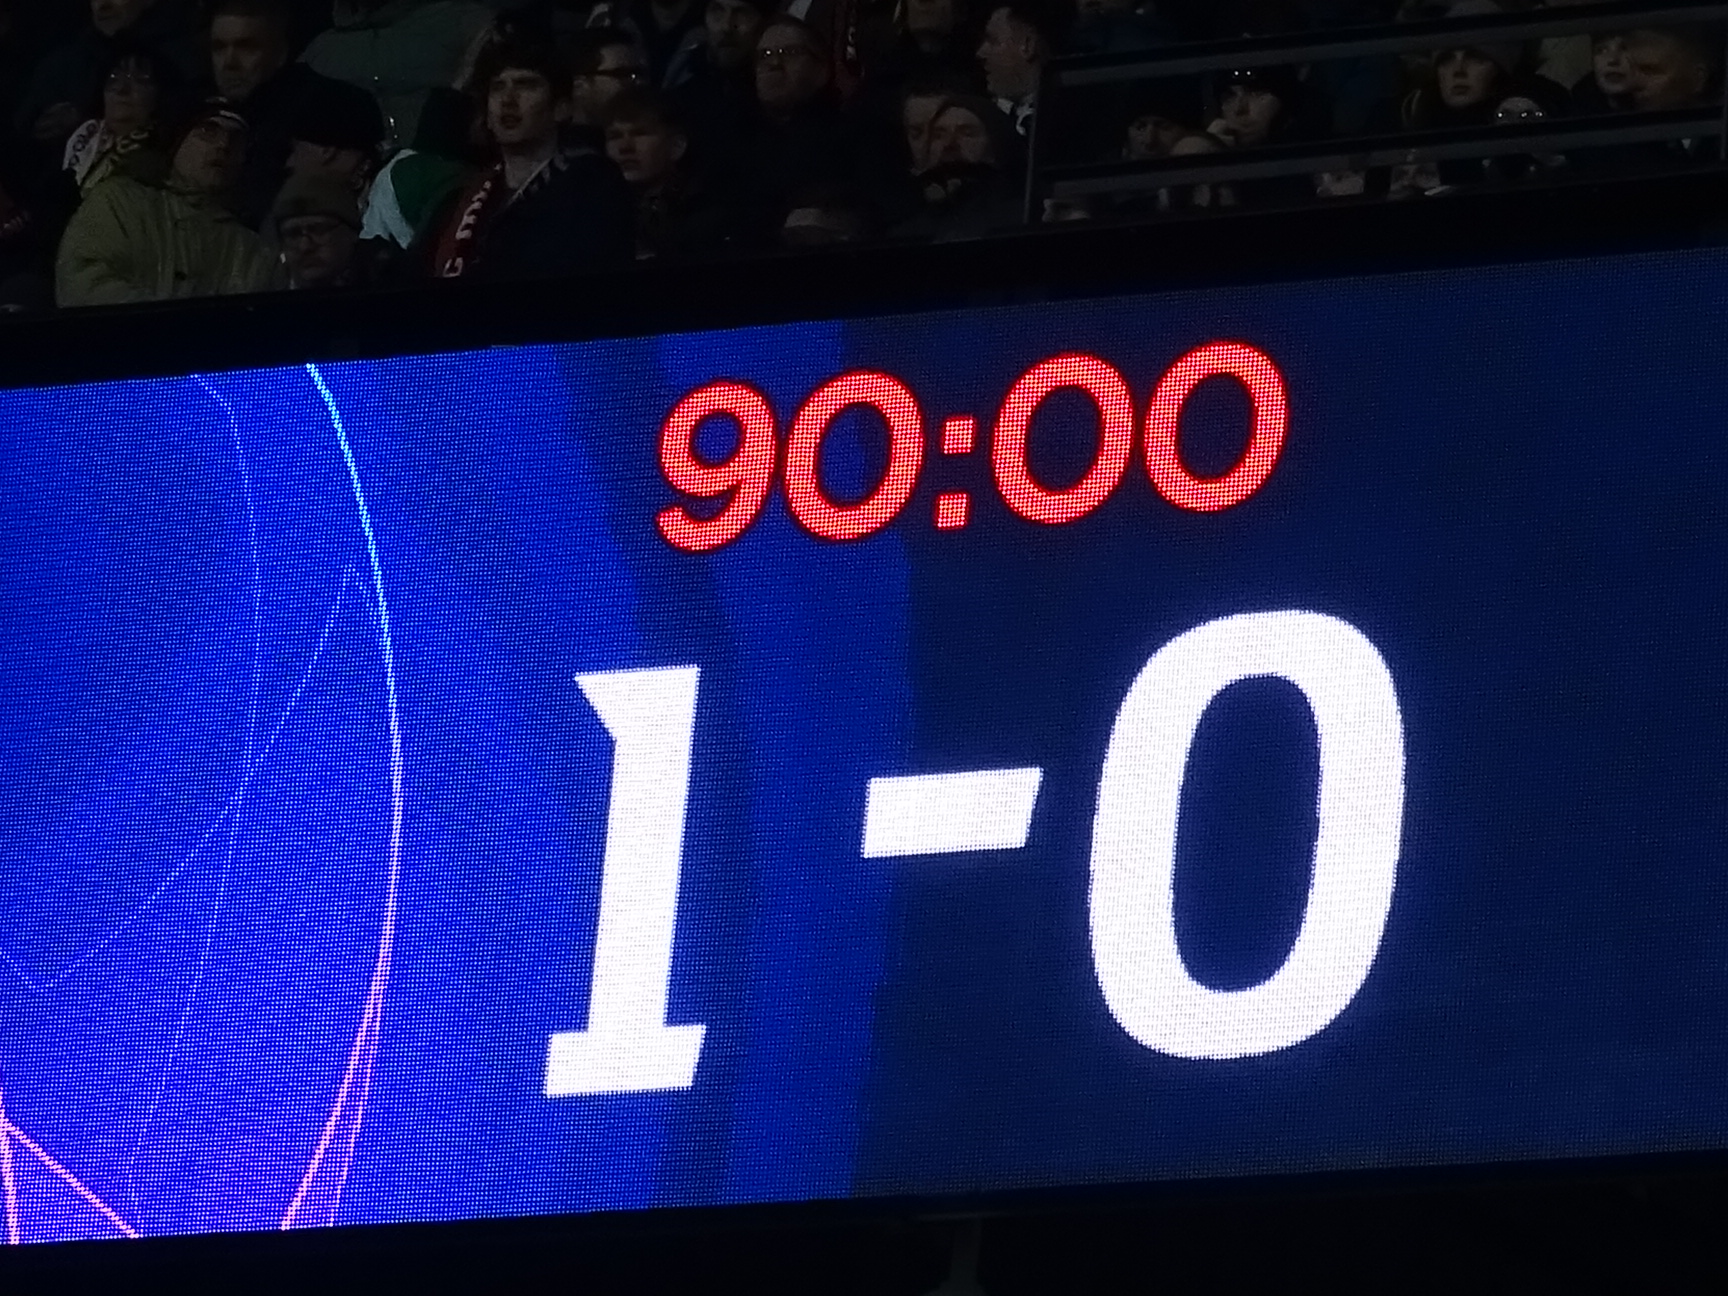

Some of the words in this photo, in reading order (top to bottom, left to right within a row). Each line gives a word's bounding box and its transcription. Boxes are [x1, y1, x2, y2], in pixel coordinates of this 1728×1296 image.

[656, 340, 1290, 552] 90:00
[543, 664, 707, 1098] 1
[1088, 609, 1406, 1061] 0
